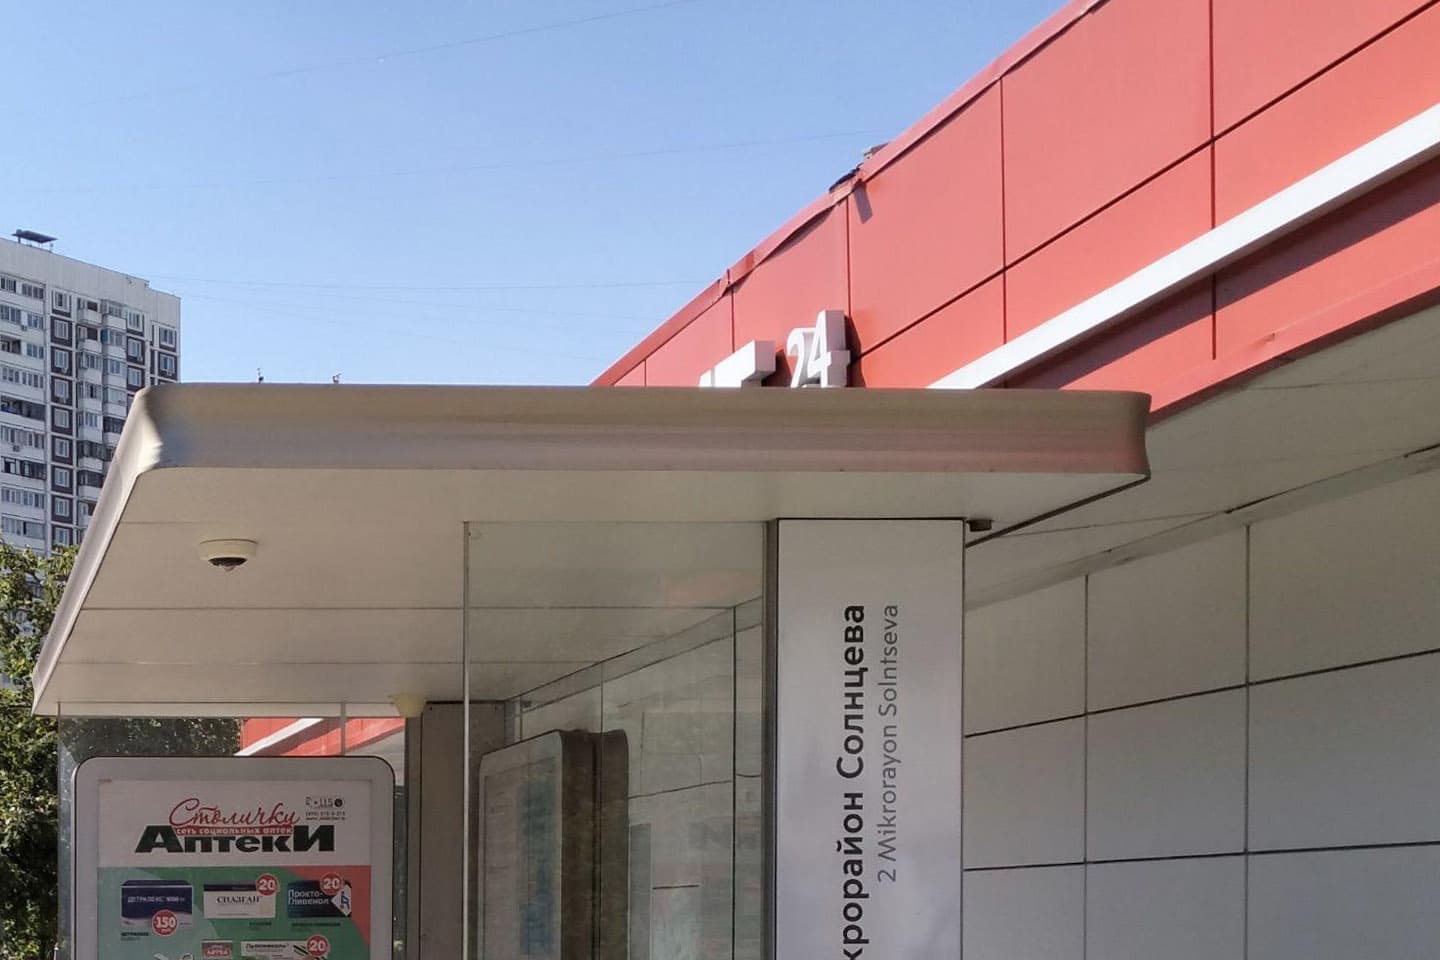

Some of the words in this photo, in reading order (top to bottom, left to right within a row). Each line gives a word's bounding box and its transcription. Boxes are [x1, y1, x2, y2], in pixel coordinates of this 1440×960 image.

[836, 605, 869, 780] Солнцева
[877, 604, 899, 717] Solntseva
[169, 797, 302, 827] Столички
[877, 725, 902, 859] Mikrorayon
[199, 827, 261, 836] социальных
[263, 827, 293, 836] аптек
[877, 870, 897, 883] 2
